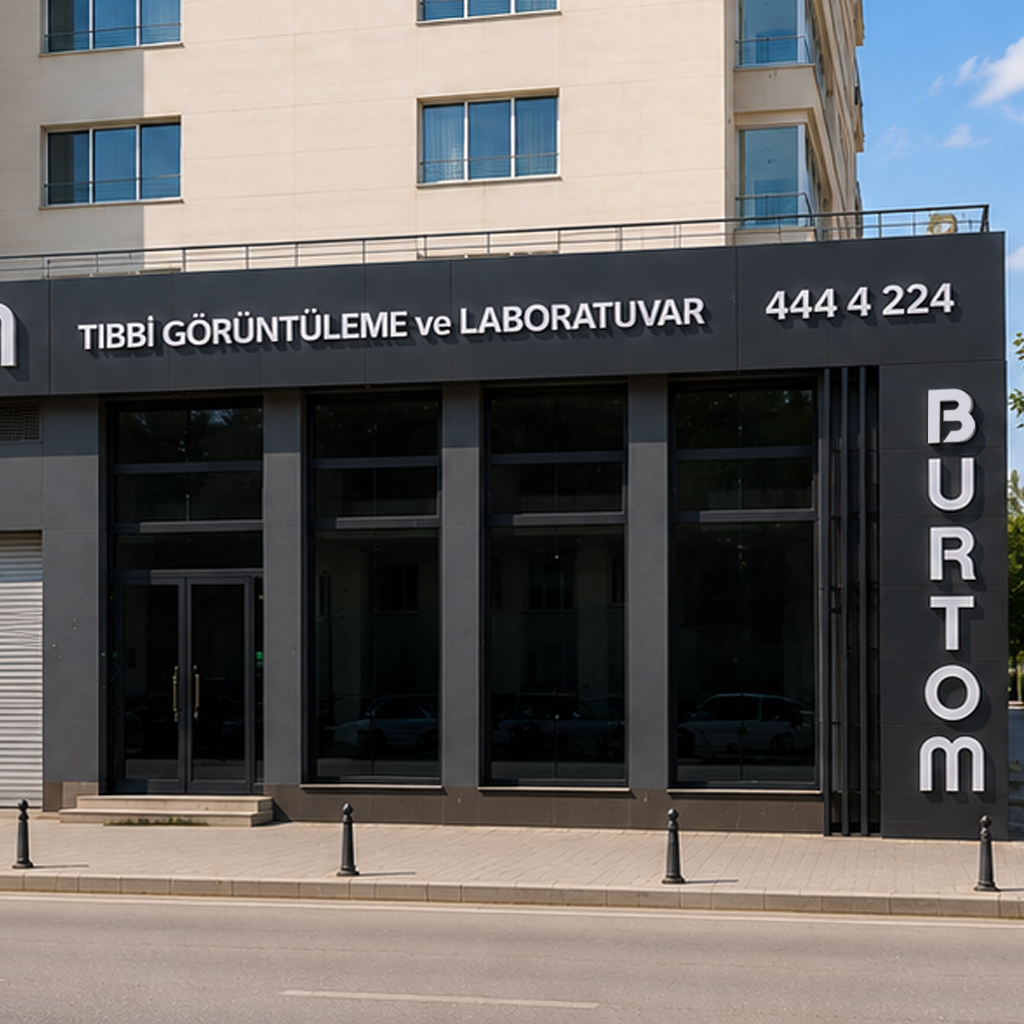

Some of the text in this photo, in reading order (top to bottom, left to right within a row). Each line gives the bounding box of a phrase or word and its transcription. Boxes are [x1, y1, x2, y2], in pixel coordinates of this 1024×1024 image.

[78, 297, 706, 351] TIBBİ GÖRÜNTÜLEME ve LABORATUVAR
[765, 282, 956, 321] 444 4 224
[919, 388, 985, 793] BURTOM
